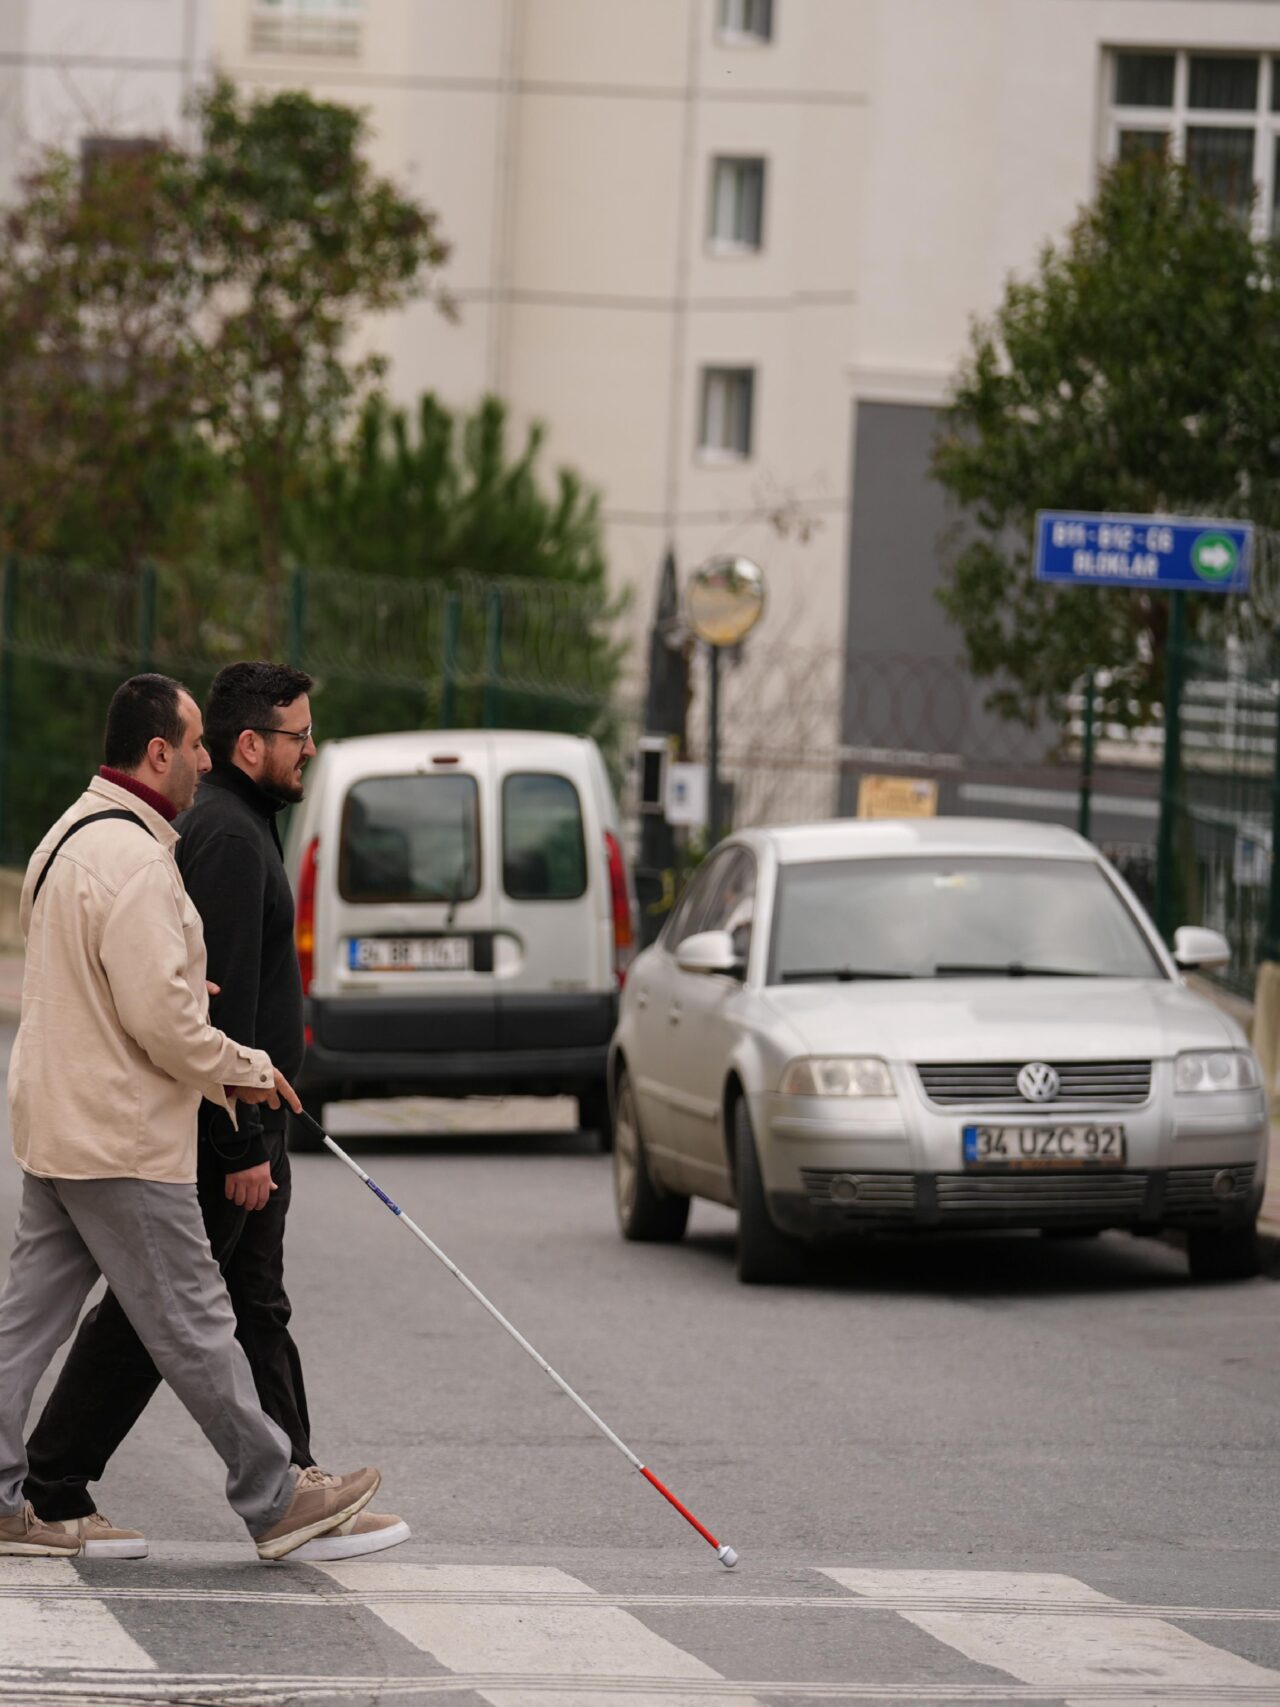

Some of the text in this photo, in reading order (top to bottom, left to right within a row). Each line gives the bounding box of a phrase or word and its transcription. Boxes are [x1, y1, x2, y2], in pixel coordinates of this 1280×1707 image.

[980, 1126, 1116, 1156] 34 UZC 92
